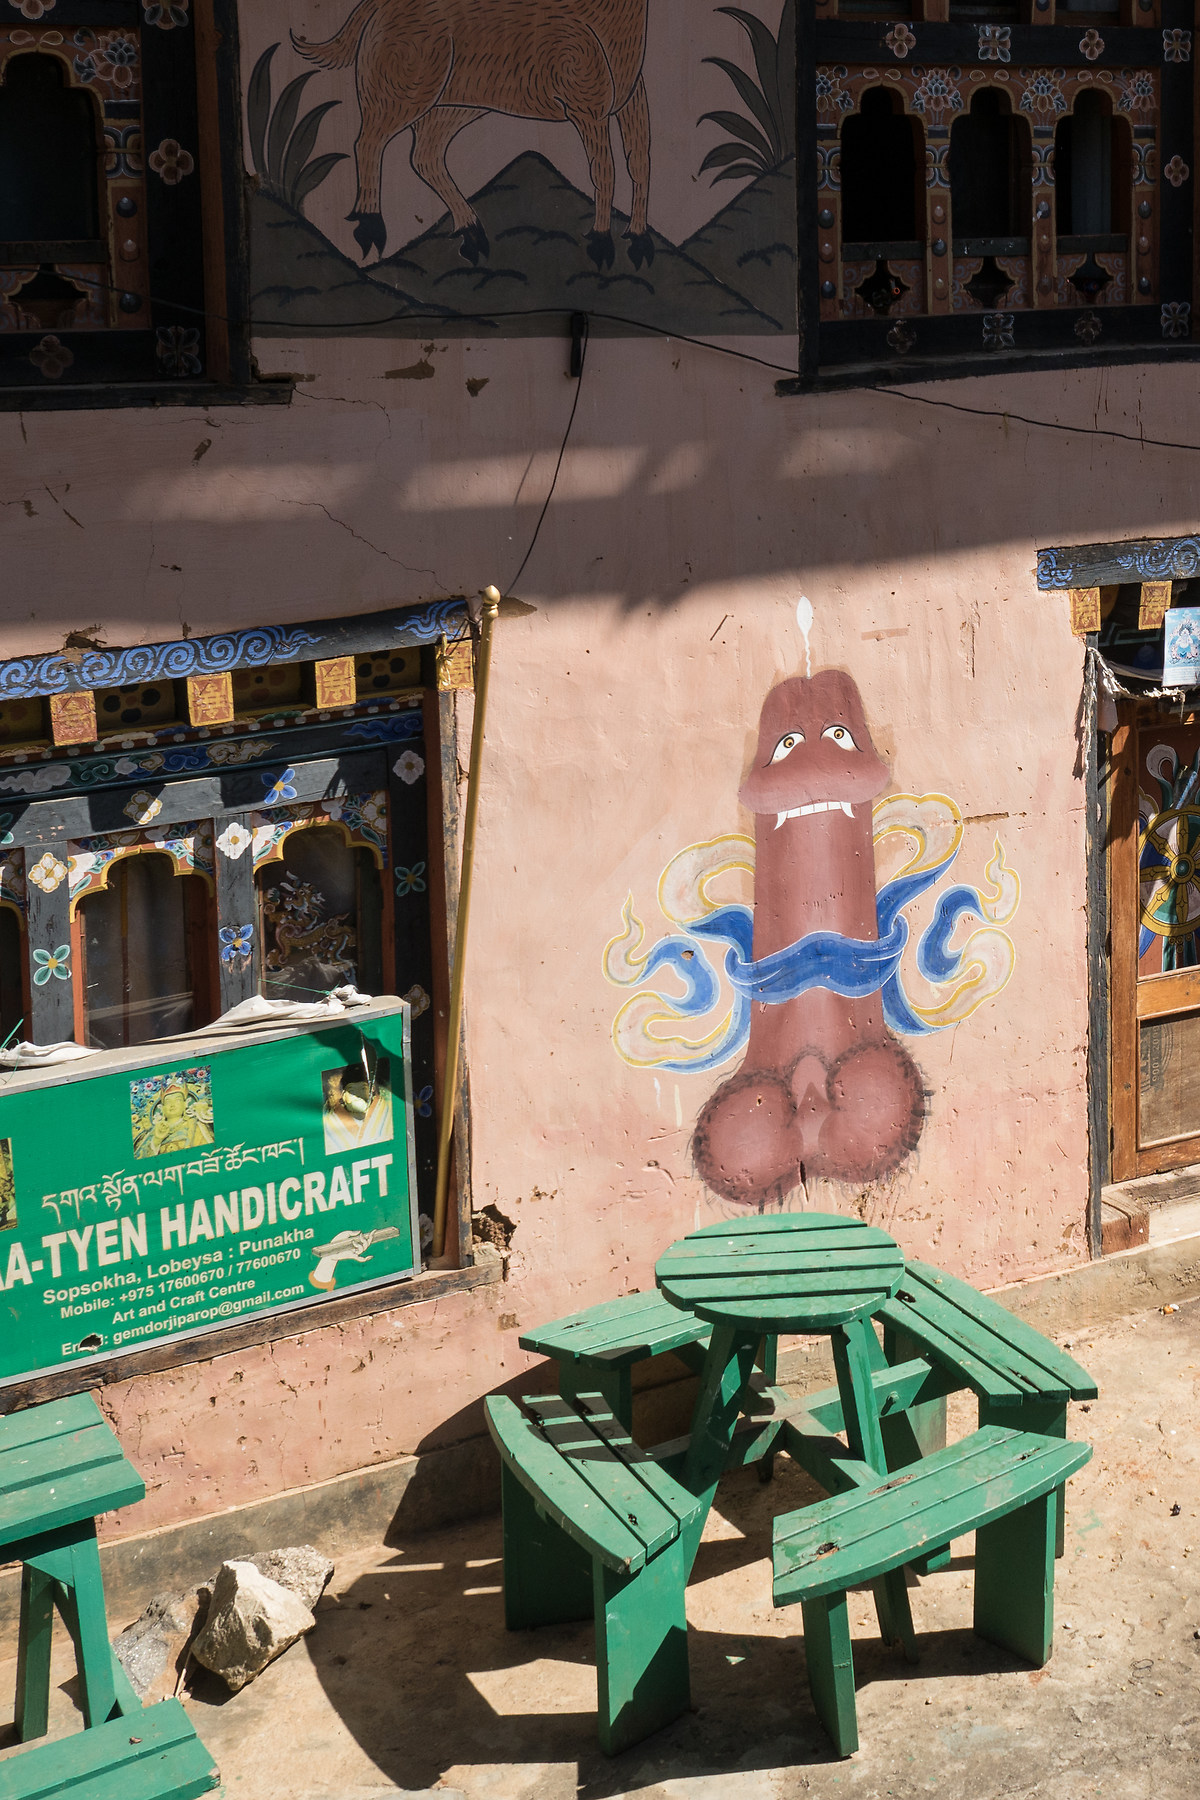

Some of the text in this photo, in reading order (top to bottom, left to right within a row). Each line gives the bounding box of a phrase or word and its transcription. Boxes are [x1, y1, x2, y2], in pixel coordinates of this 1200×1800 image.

[0, 1153, 394, 1292] A-TYEN HANDICRAFT
[43, 1271, 142, 1305] Sopsokha,
[147, 1250, 223, 1280] Lobeysa
[239, 1227, 315, 1256] Punakha
[60, 1296, 115, 1319] Mobile:
[119, 1284, 155, 1303] +975
[158, 1267, 225, 1294] 17600670
[236, 1247, 301, 1274] 77600670
[111, 1279, 256, 1325] Art and Craft Centre
[113, 1284, 305, 1345] gemdorjiparop@gmail.com
